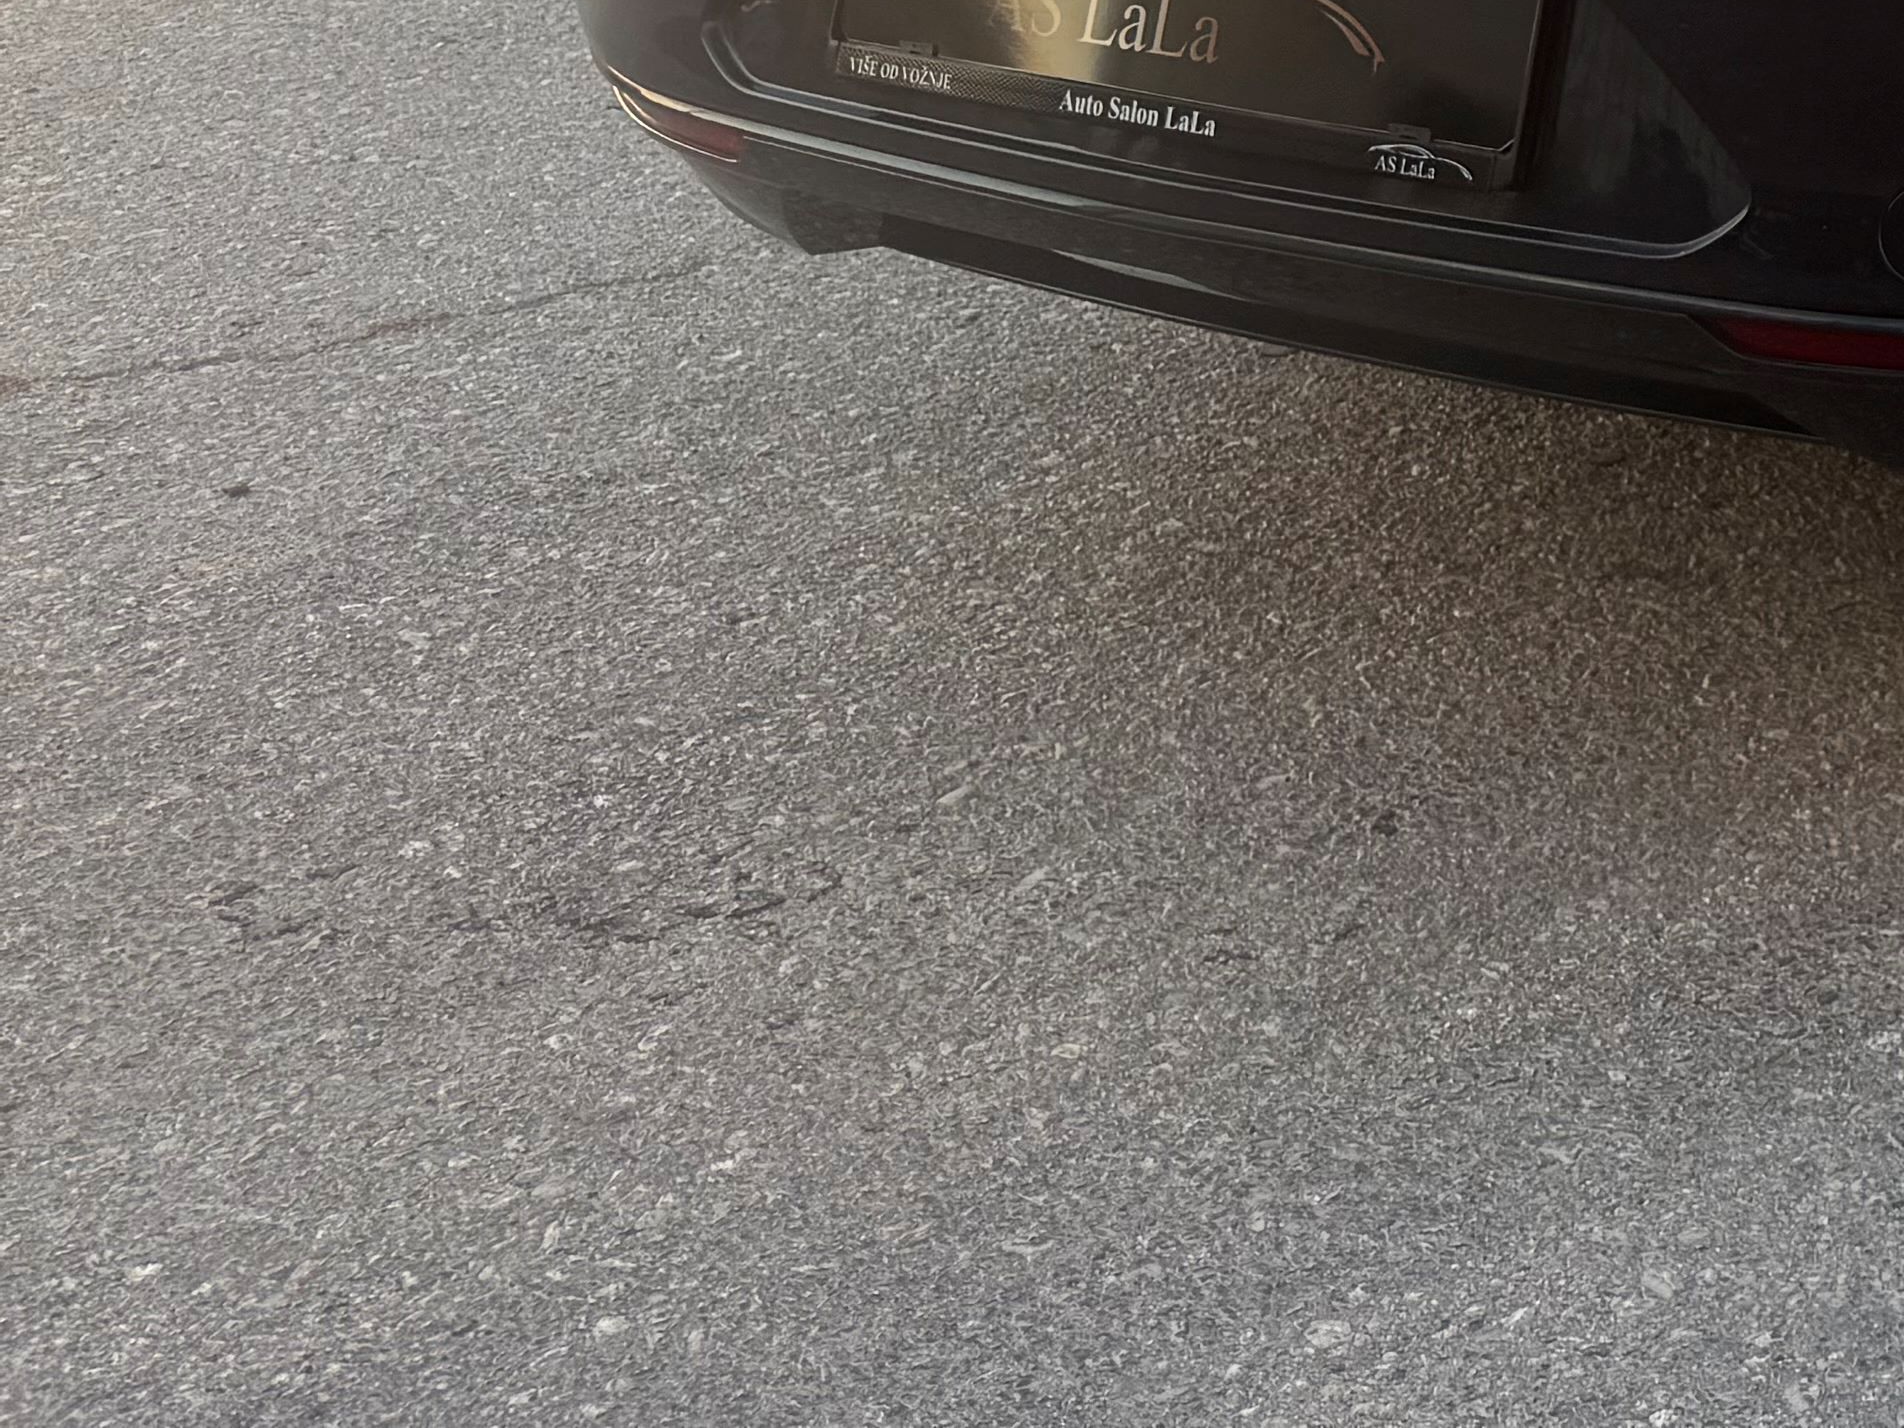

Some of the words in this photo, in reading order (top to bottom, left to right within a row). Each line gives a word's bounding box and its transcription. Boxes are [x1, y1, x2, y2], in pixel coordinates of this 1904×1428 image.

[849, 54, 879, 77] VIŠE
[880, 62, 900, 80] OD
[1058, 89, 1104, 117] Auto
[1107, 95, 1160, 127] Salon
[1164, 105, 1217, 137] LaLa
[1374, 154, 1398, 174] AS
[1399, 158, 1436, 180] LaLa
